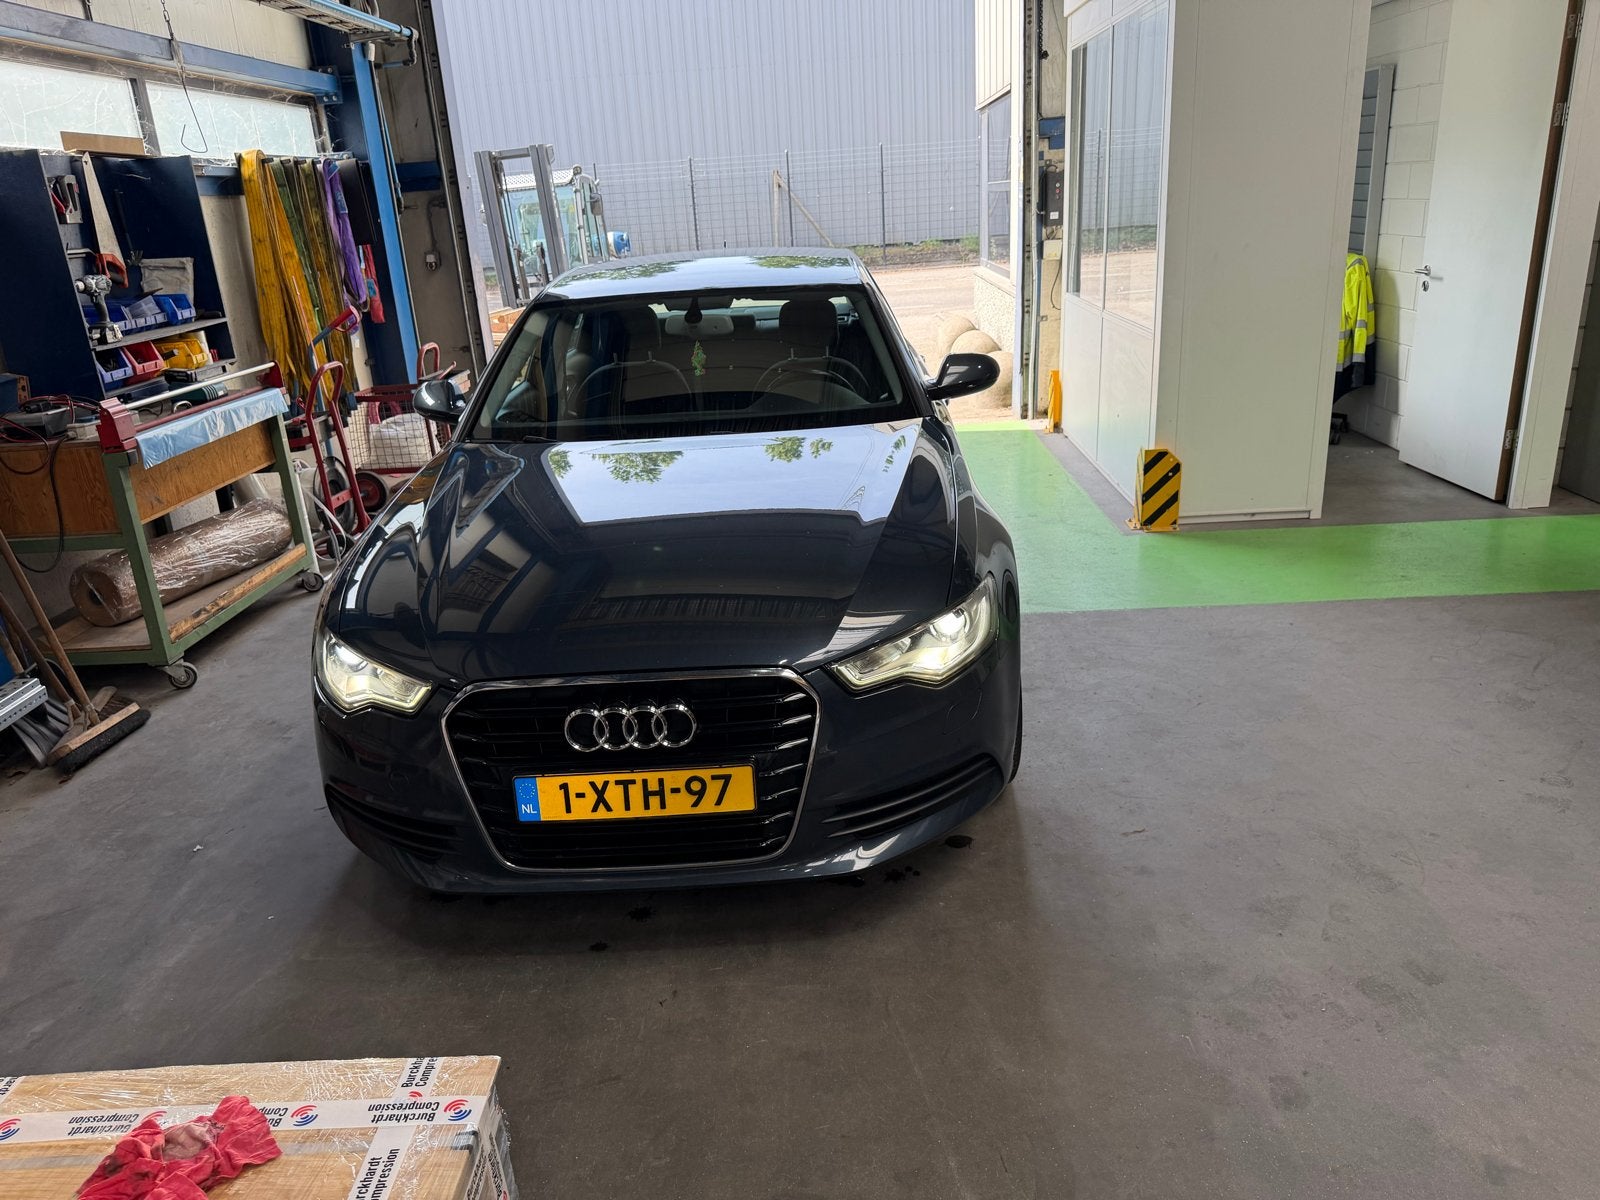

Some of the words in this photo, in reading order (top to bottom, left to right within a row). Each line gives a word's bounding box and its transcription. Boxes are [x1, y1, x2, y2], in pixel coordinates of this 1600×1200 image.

[559, 774, 732, 814] 1-XTH-97
[521, 803, 538, 814] NL
[368, 1101, 440, 1113] Compression
[68, 1113, 140, 1125] Compression
[371, 1112, 436, 1124] Burckhardt
[355, 1156, 382, 1200] rckhardt
